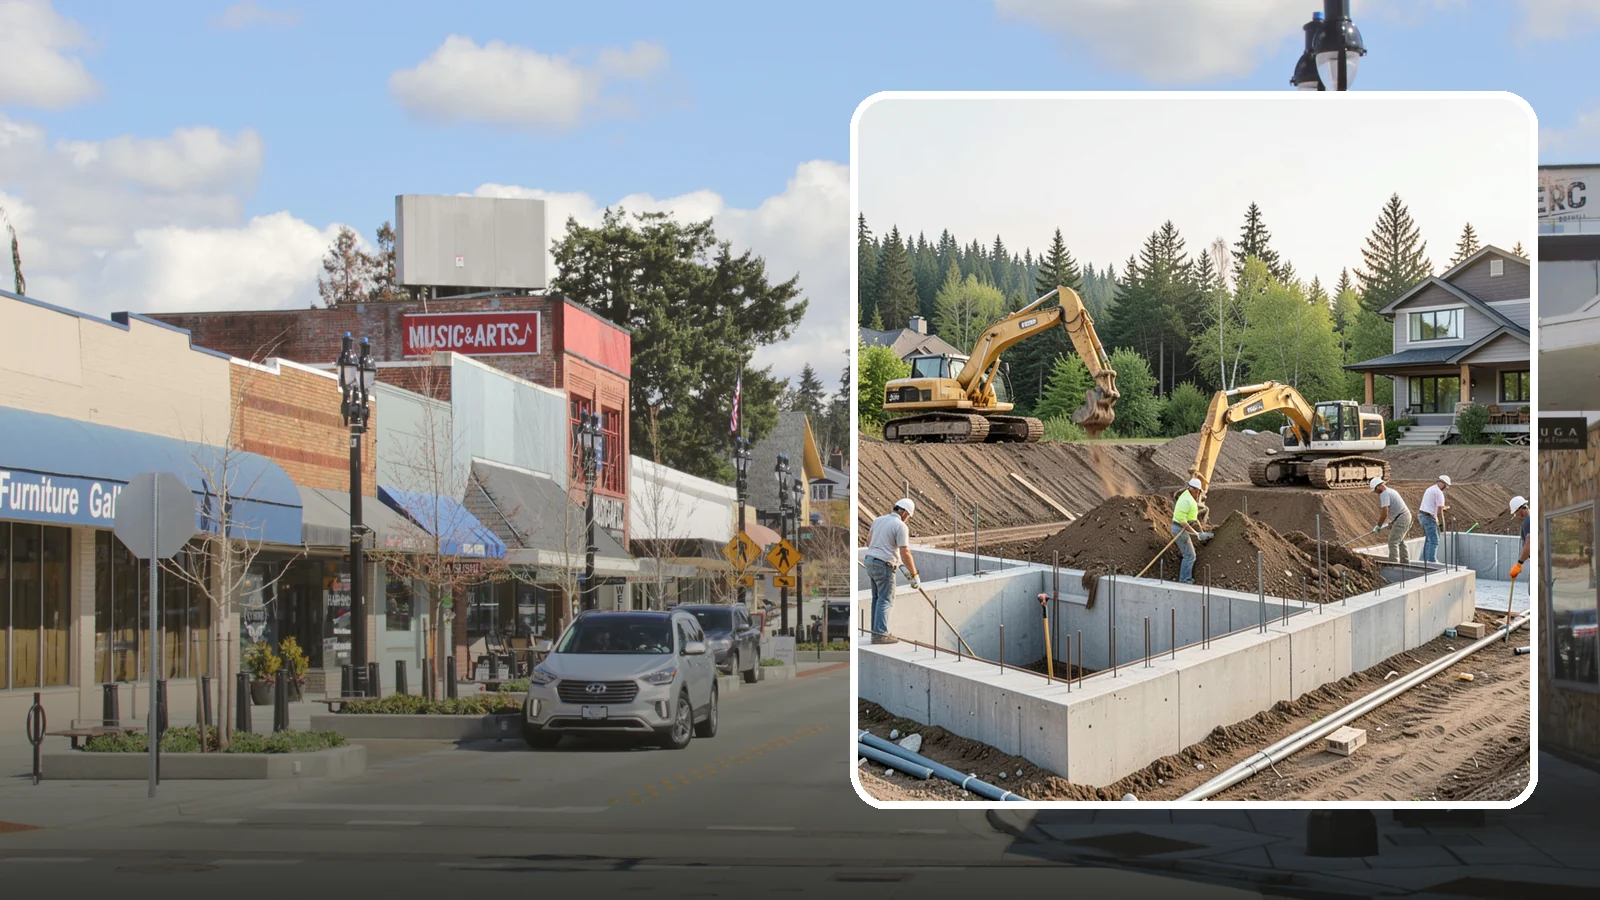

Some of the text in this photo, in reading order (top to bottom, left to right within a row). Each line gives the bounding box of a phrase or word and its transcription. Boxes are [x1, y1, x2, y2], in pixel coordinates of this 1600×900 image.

[408, 323, 520, 349] MUSIC&ARTS
[0, 471, 122, 519] Furniture Gal
[453, 563, 480, 574] SUSHI
